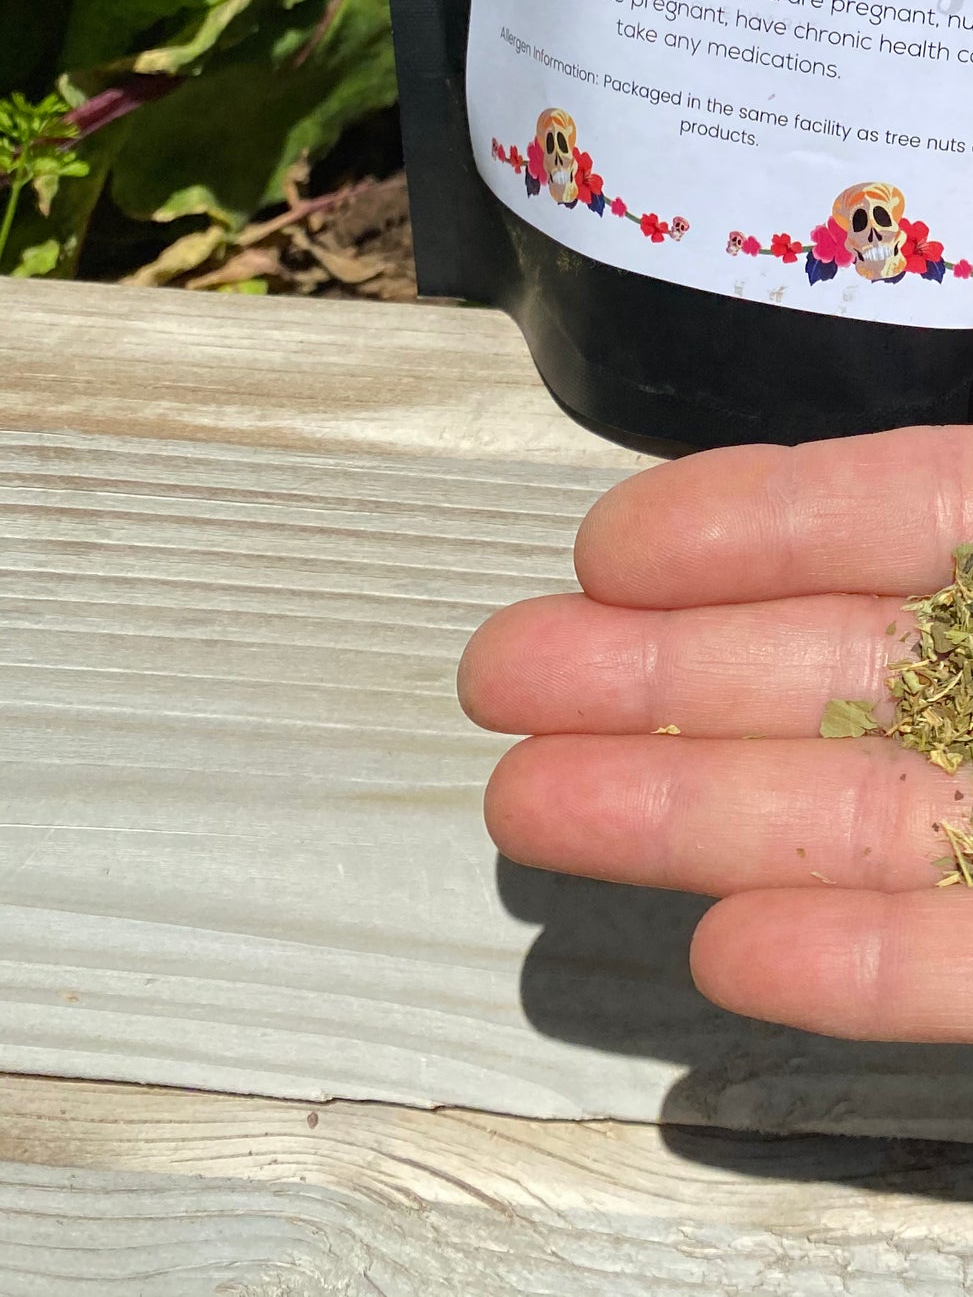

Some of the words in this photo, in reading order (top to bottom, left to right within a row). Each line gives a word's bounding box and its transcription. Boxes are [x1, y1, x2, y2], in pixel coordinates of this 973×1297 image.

[616, 18, 658, 43] take
[664, 32, 702, 57] any
[708, 42, 841, 79] medications.
[735, 8, 787, 36] have
[793, 21, 873, 51] chronic
[879, 33, 950, 61] health
[500, 26, 532, 55] Allergen
[534, 46, 599, 86] Information:
[603, 73, 683, 106] Packaged
[686, 96, 701, 110] in
[706, 97, 734, 117] the
[738, 107, 789, 127] same
[794, 113, 852, 142] facility
[856, 128, 879, 143] as
[884, 130, 921, 148] tree
[926, 137, 966, 154] nuts
[680, 119, 759, 147] products.
